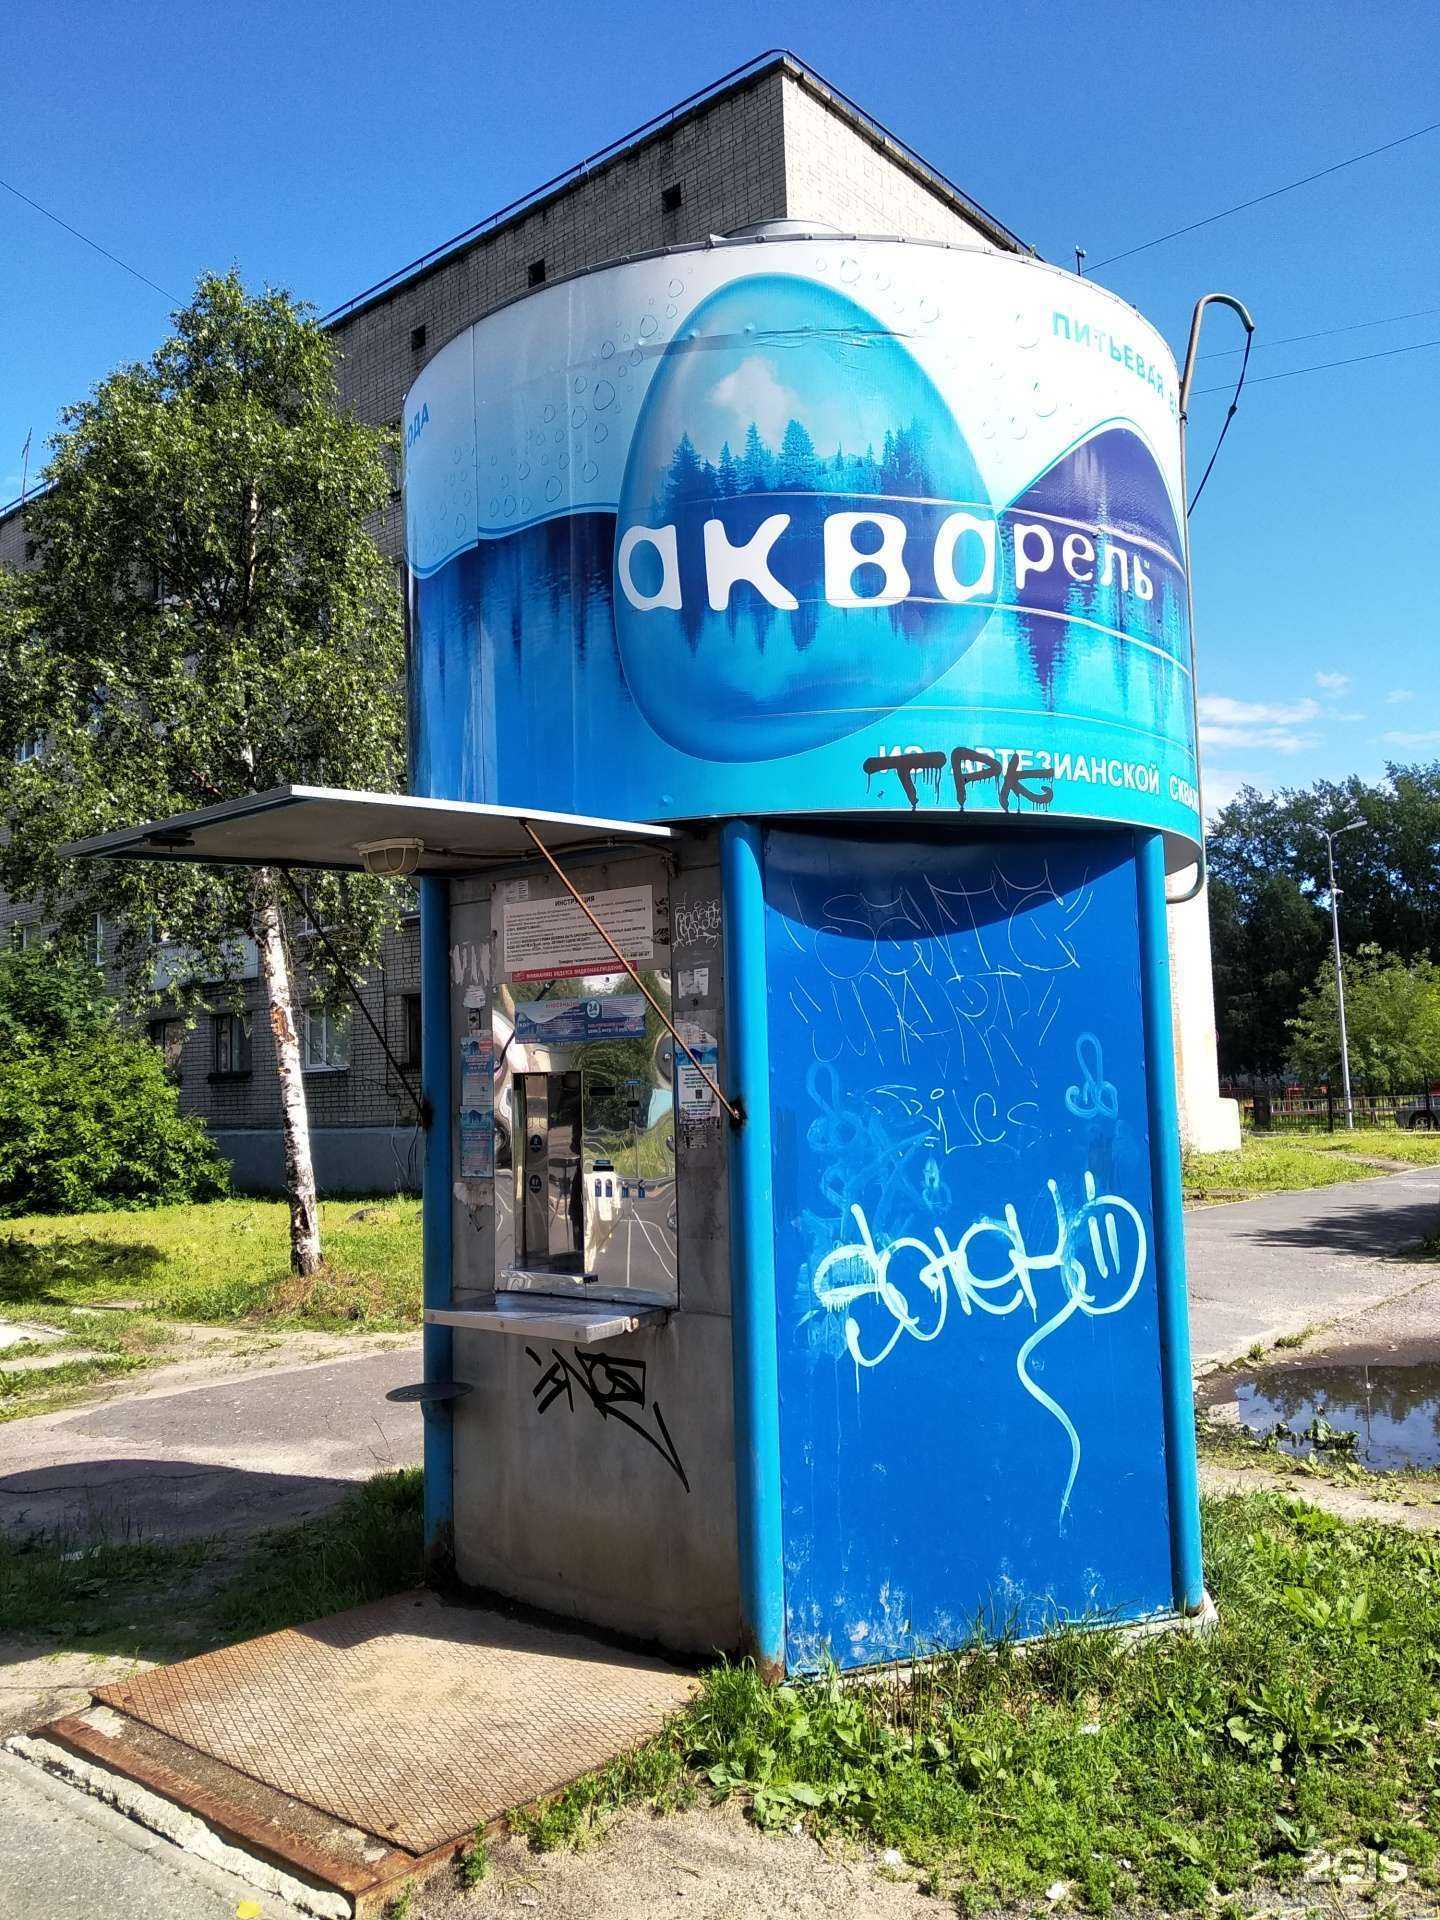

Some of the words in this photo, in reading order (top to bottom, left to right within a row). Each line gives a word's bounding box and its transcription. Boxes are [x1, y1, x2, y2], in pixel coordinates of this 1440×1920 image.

[1052, 311, 1164, 400] ПИТЬЕВАЯ
[407, 402, 430, 449] ОДА
[554, 895, 595, 907] ИНСТРИЯ
